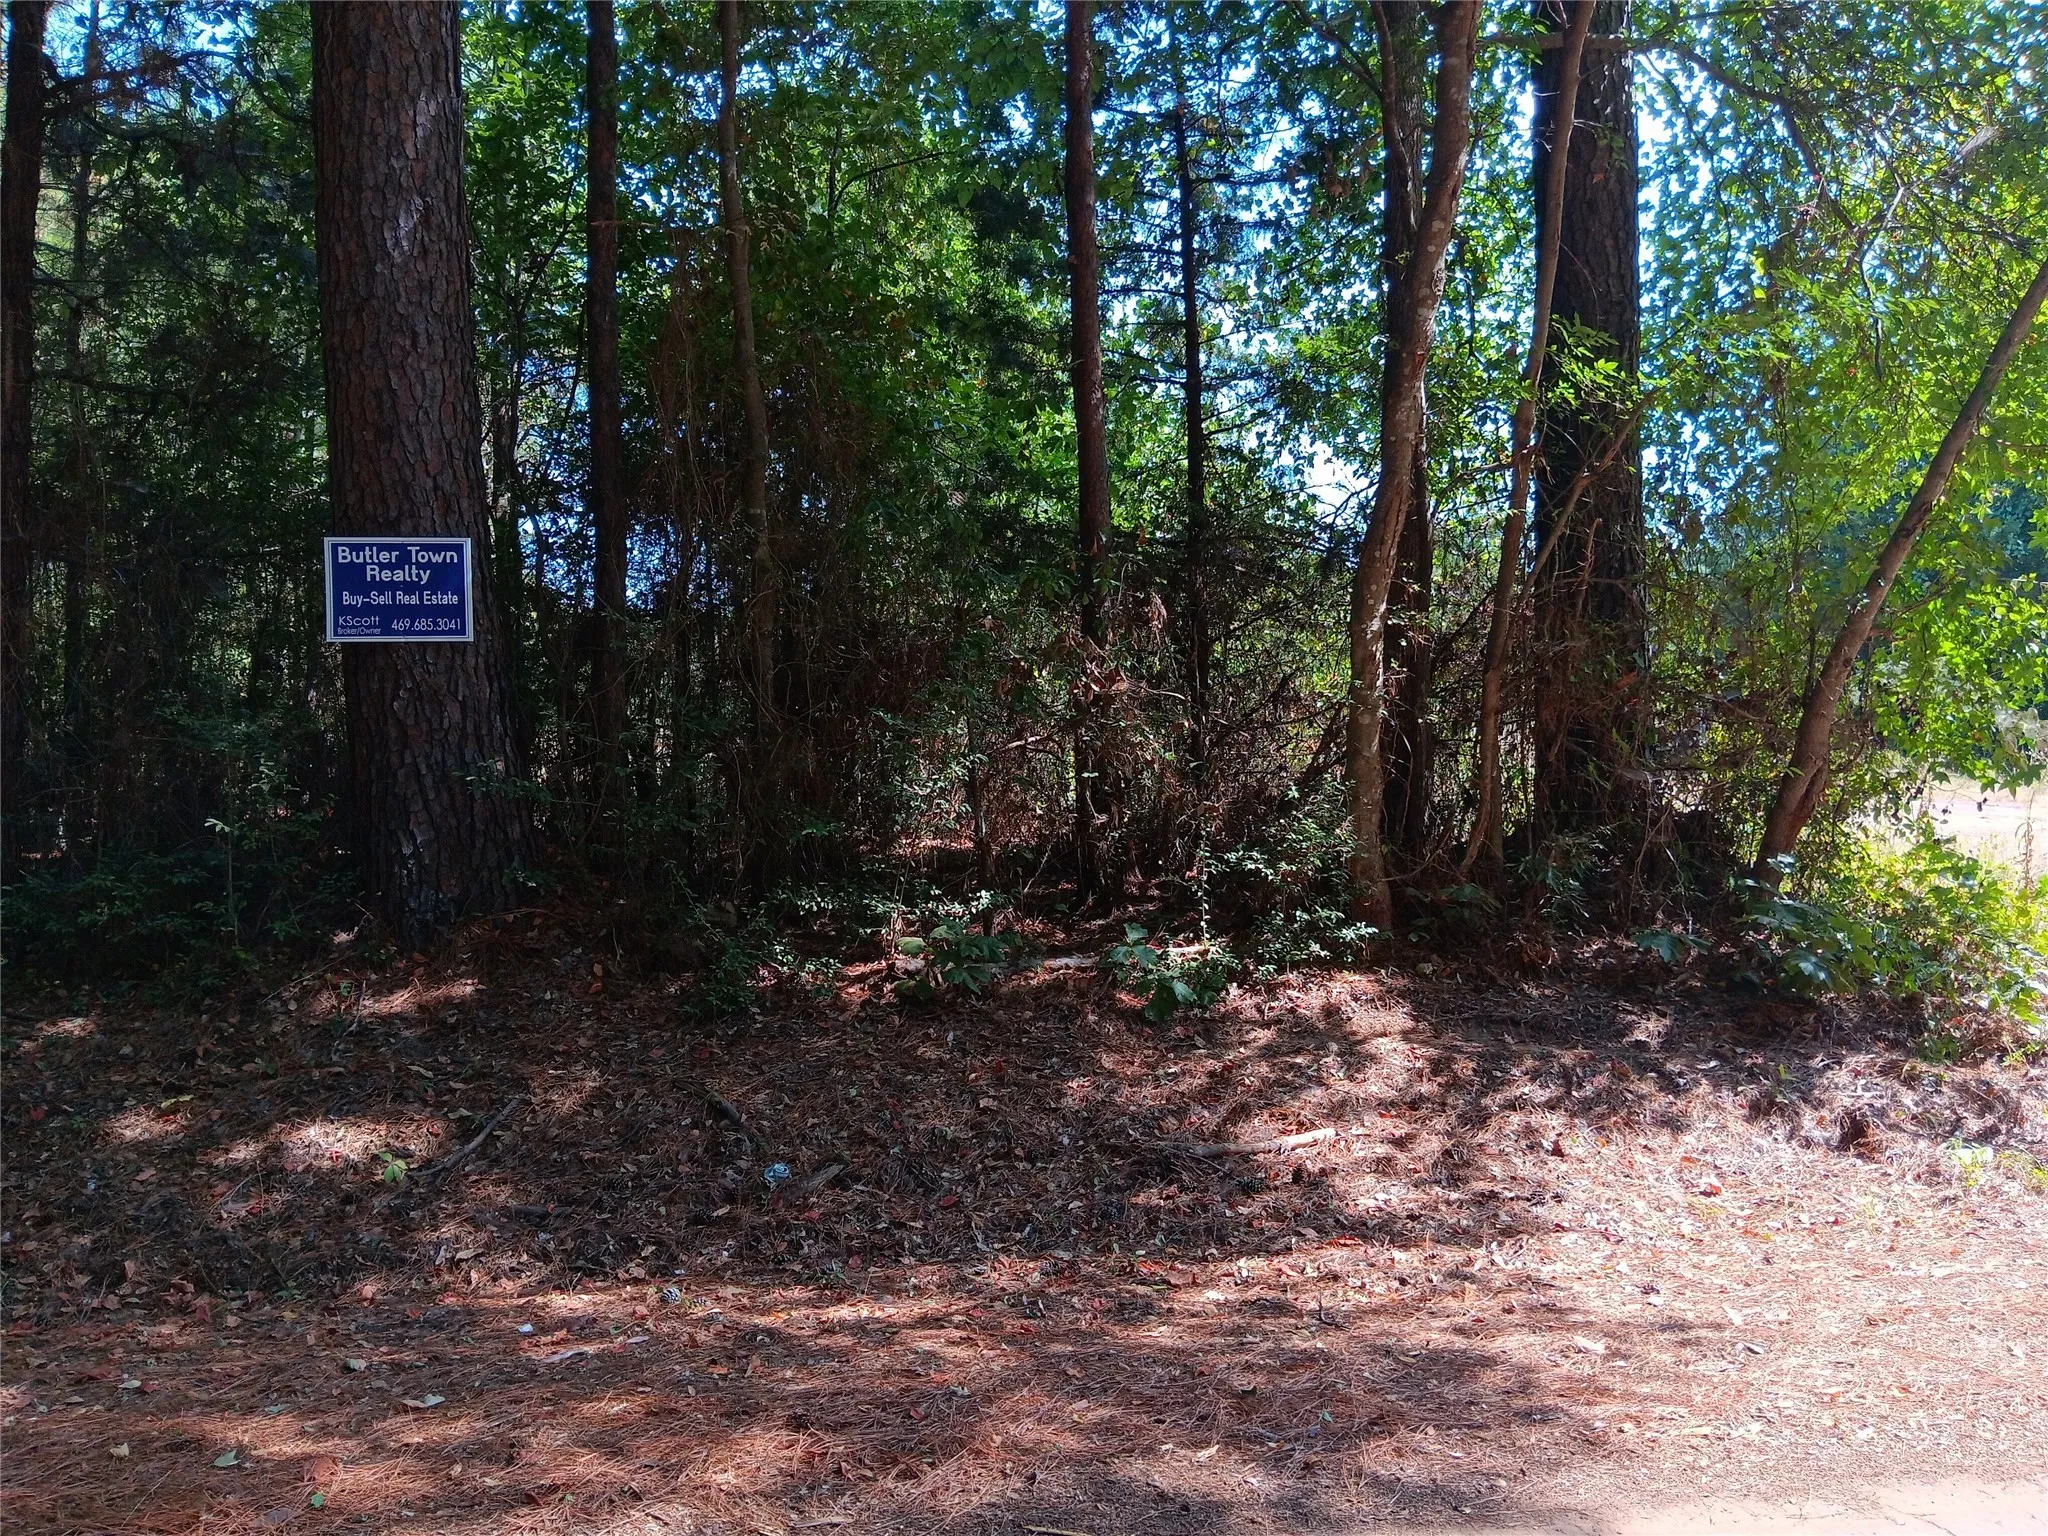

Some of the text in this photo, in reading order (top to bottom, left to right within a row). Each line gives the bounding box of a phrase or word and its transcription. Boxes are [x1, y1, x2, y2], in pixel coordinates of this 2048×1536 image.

[337, 546, 458, 563] Butler Town
[366, 565, 431, 585] Realty
[396, 591, 420, 605] Real
[423, 591, 458, 605] Estate
[338, 615, 380, 626] KScott
[391, 618, 461, 631] 469.685.3041
[337, 627, 381, 635] Broker/Owner
